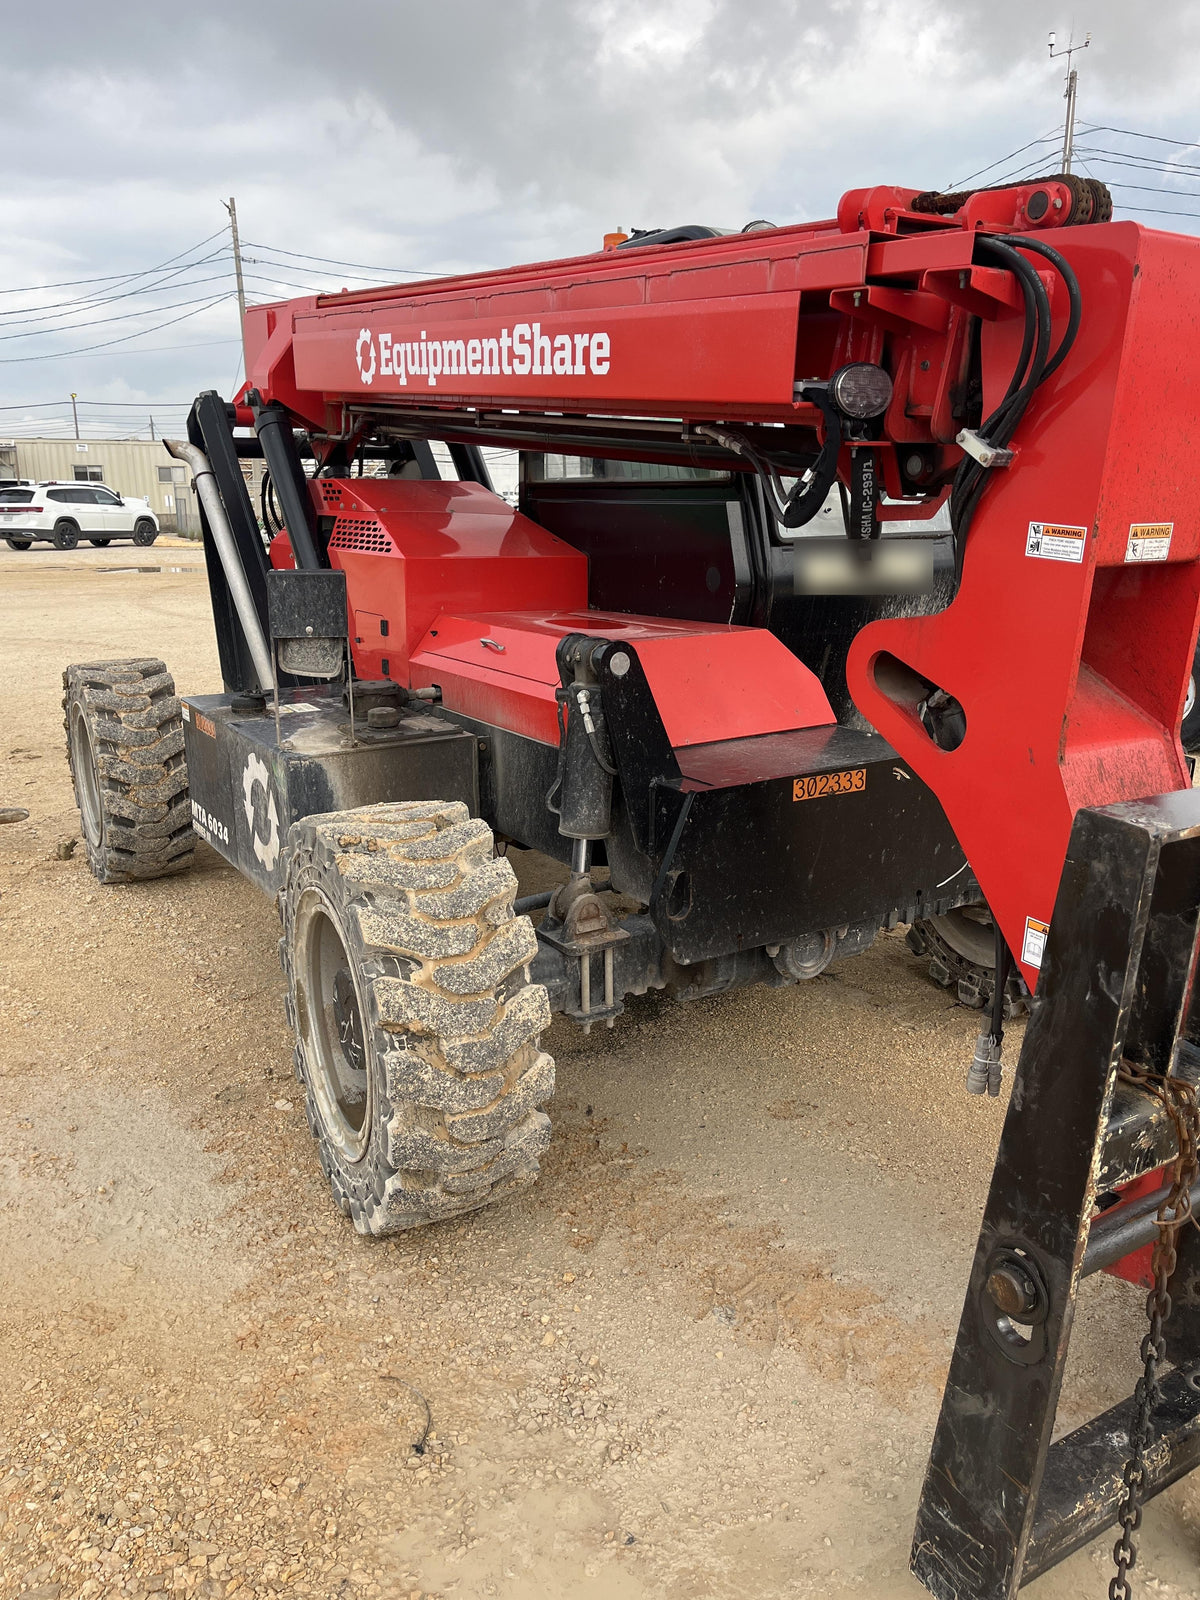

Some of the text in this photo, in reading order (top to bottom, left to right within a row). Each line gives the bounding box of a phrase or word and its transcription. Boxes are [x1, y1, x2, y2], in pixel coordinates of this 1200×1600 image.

[378, 322, 611, 386] EquipmentShare
[1051, 528, 1082, 538] WARNING
[1140, 527, 1170, 537] WARNING
[795, 770, 865, 800] 302333
